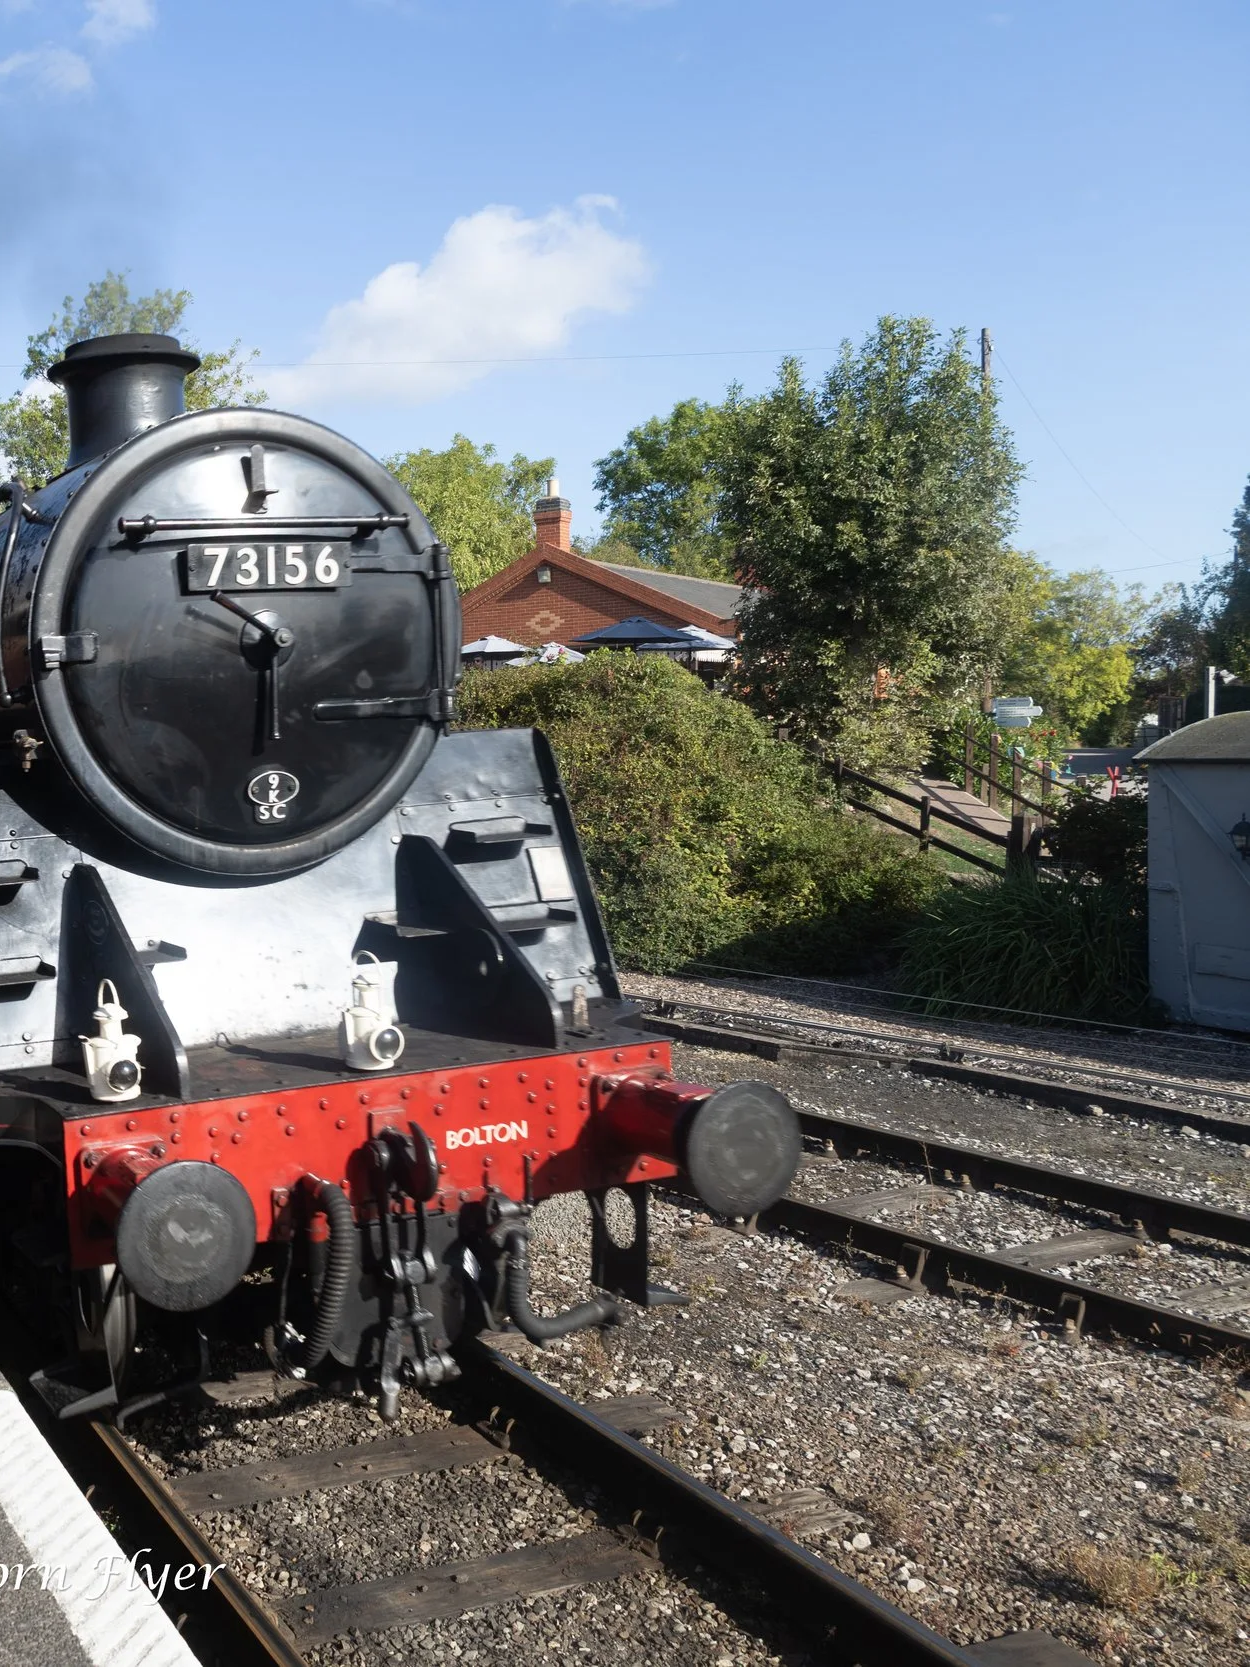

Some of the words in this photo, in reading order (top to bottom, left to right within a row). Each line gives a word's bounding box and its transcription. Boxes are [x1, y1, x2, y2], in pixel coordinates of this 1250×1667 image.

[203, 545, 340, 587] 73156
[268, 773, 280, 790] 9
[268, 789, 281, 803] K
[259, 803, 287, 820] SC
[445, 1119, 529, 1150] BOLTON
